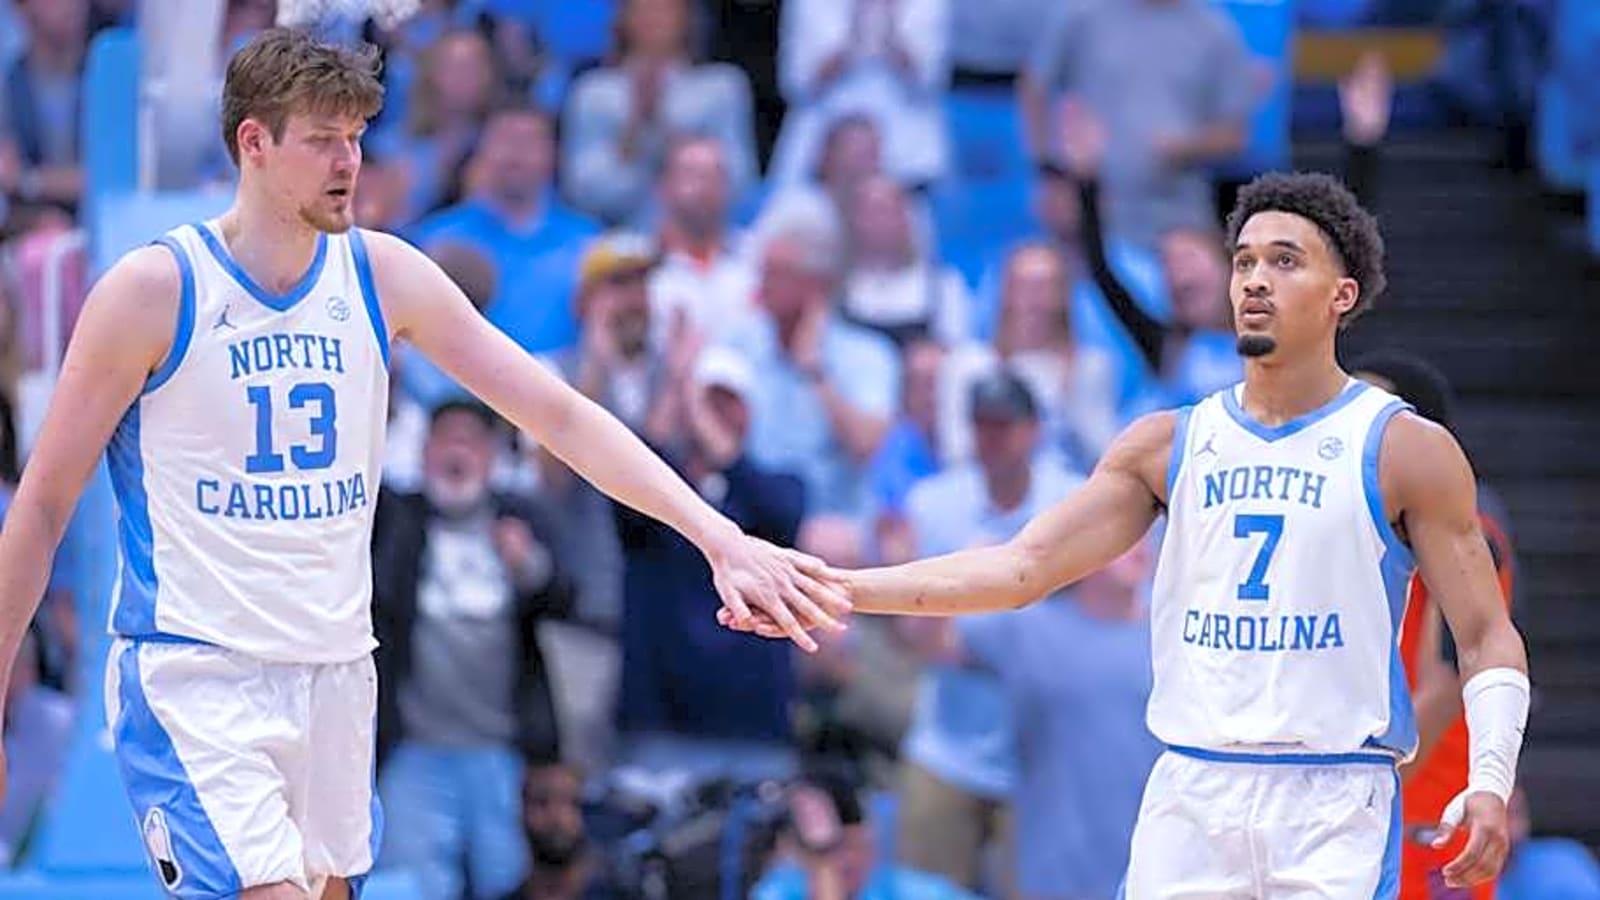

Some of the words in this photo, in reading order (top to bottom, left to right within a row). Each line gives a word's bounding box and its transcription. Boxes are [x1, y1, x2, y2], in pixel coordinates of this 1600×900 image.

[228, 333, 344, 379] NORTH
[245, 382, 337, 473] 13
[196, 472, 367, 520] CAROLINA
[1203, 465, 1327, 509] NORTH
[1234, 514, 1285, 601] 7
[1183, 610, 1344, 652] CAROLINA
